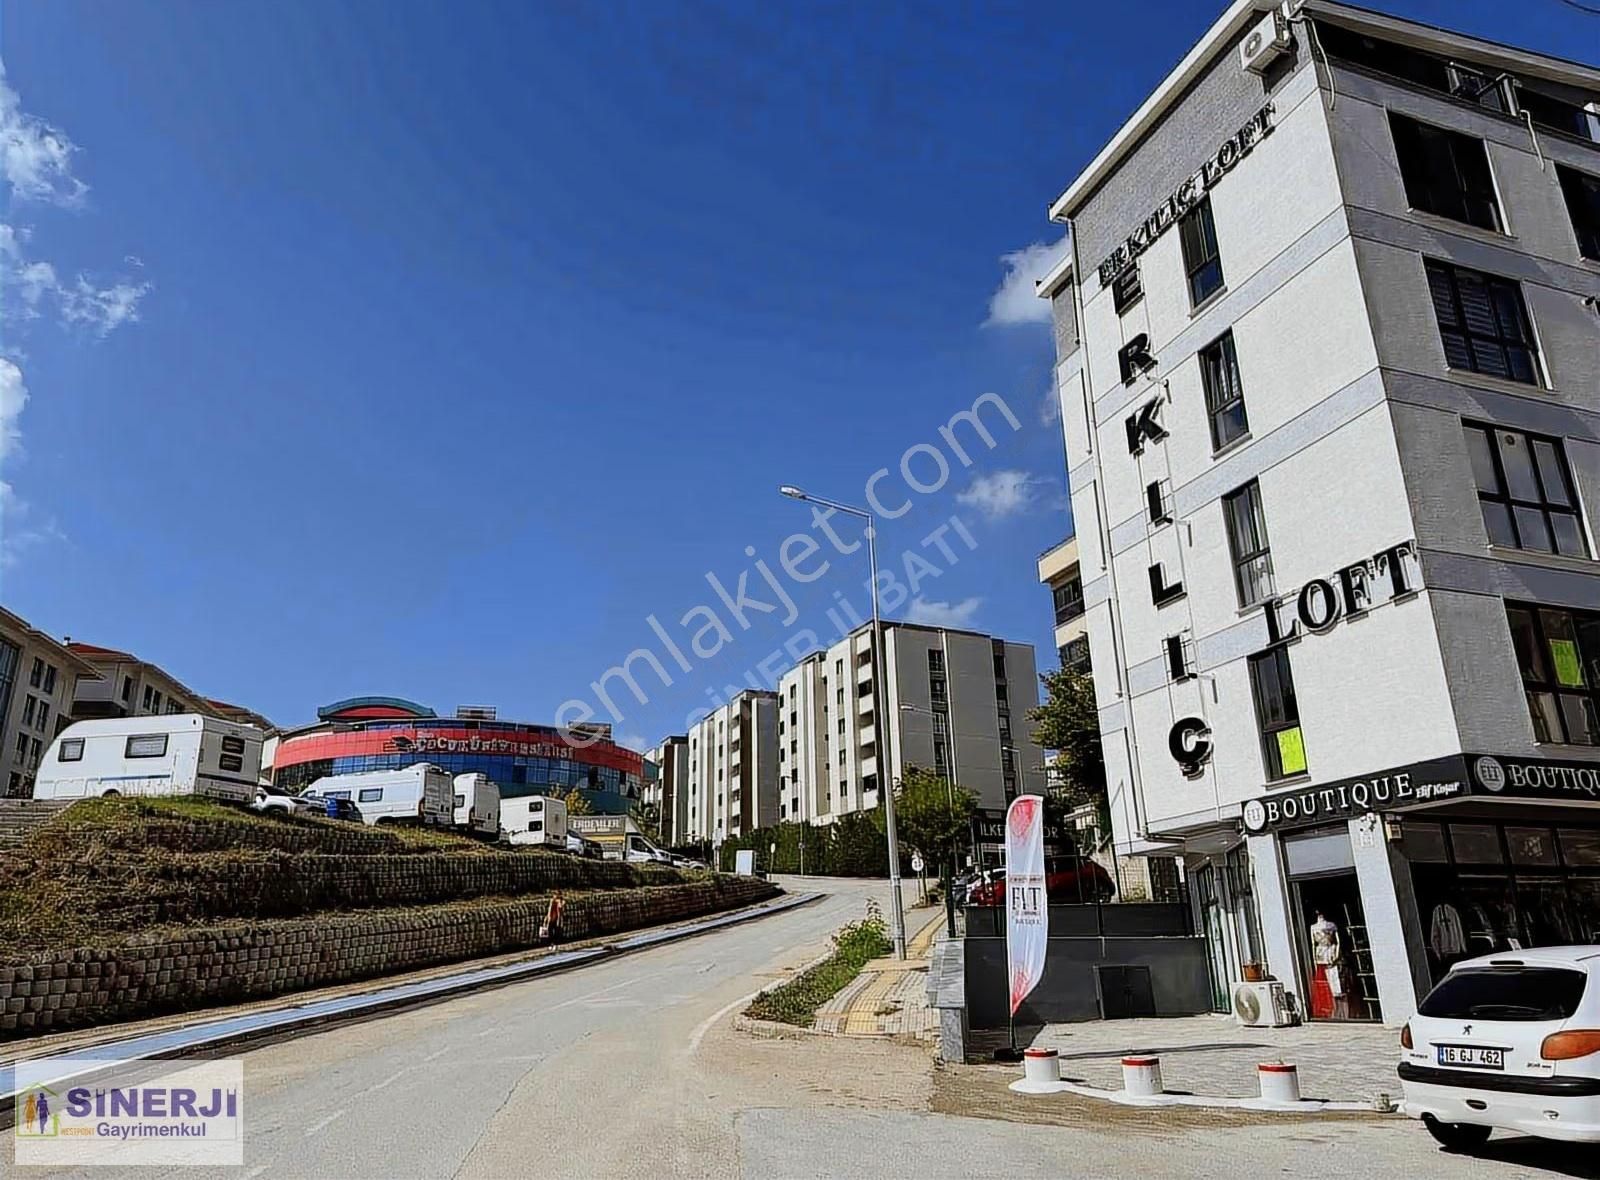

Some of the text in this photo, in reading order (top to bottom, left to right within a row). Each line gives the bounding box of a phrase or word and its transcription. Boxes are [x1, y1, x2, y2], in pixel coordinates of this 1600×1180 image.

[1200, 103, 1276, 192] LOFT
[1262, 539, 1419, 647] LOFT
[1267, 773, 1413, 822] BOUTIQUE
[1445, 1049, 1500, 1064] 16 GJ 462
